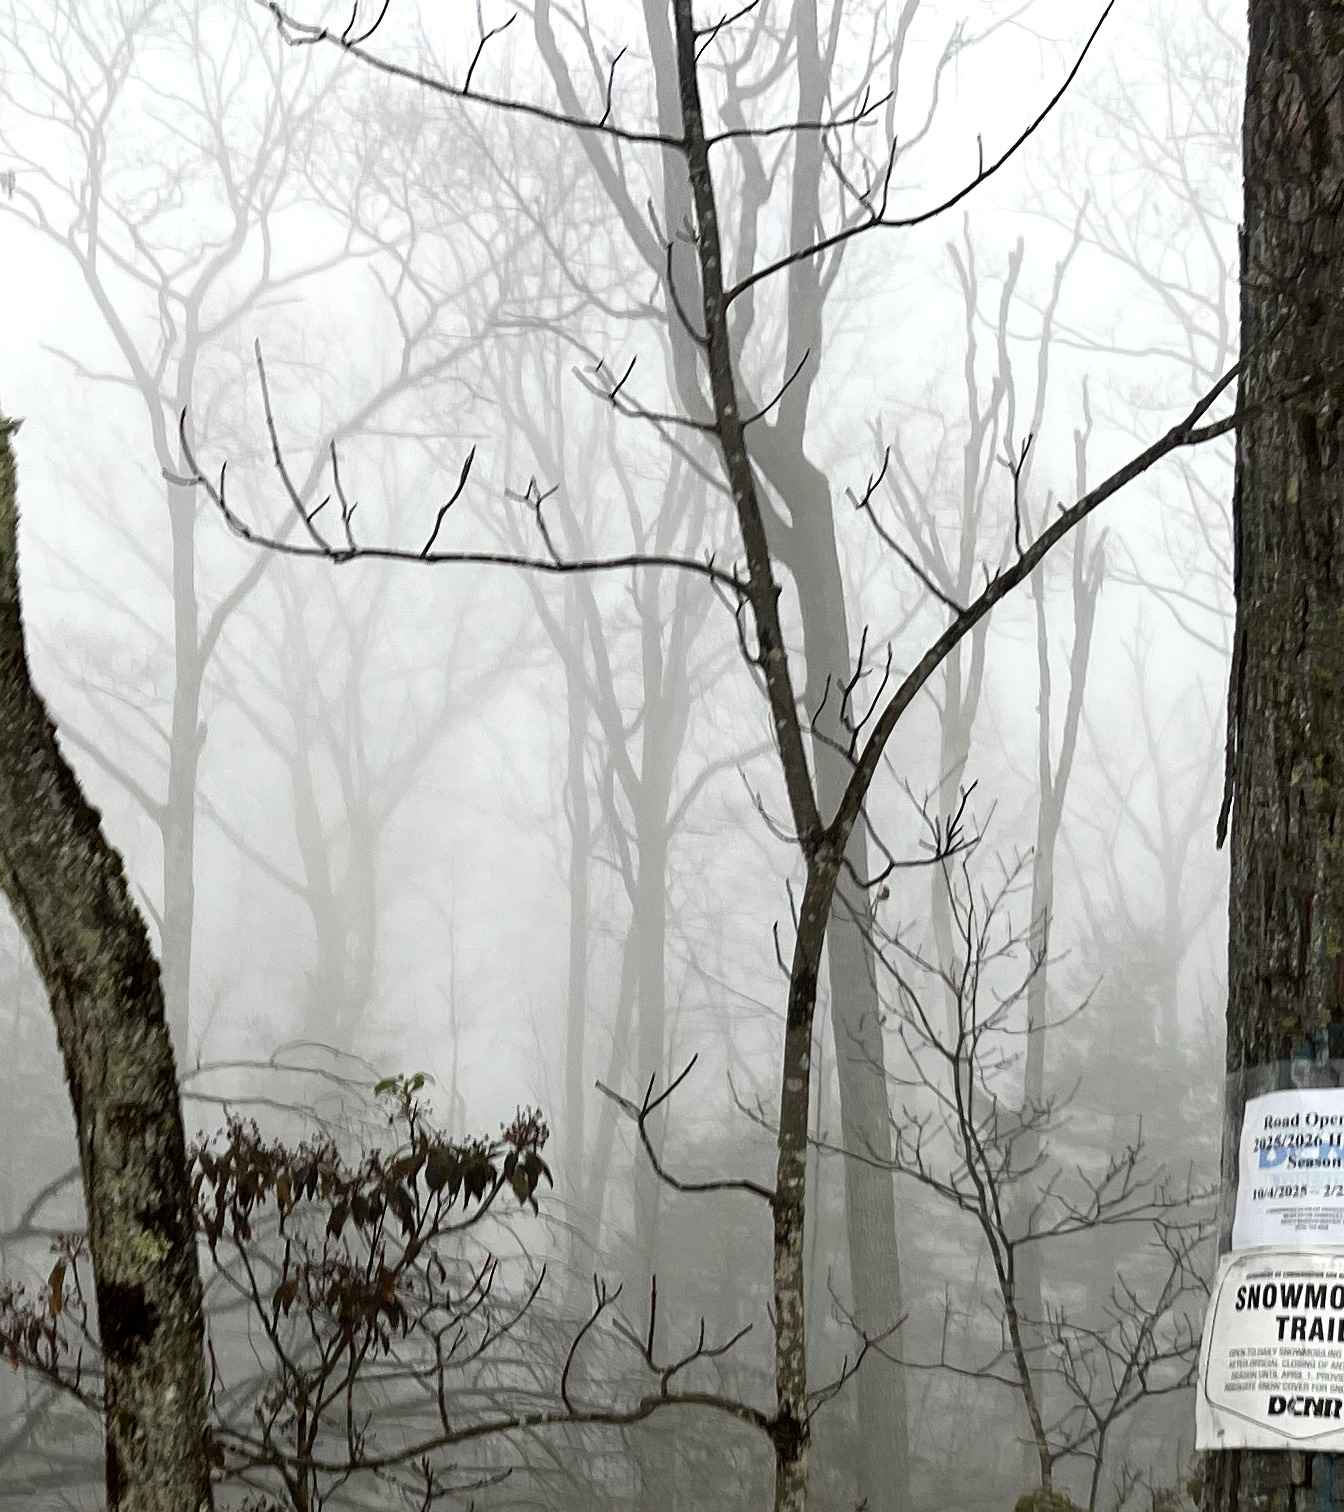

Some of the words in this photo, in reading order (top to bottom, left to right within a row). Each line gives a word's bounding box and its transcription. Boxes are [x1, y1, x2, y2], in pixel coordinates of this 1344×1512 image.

[1264, 1113, 1299, 1129] Road
[1254, 1134, 1323, 1152] 2025/2026
[1253, 1184, 1307, 1200] 10/4/2025
[1268, 1395, 1343, 1418] DCNR
